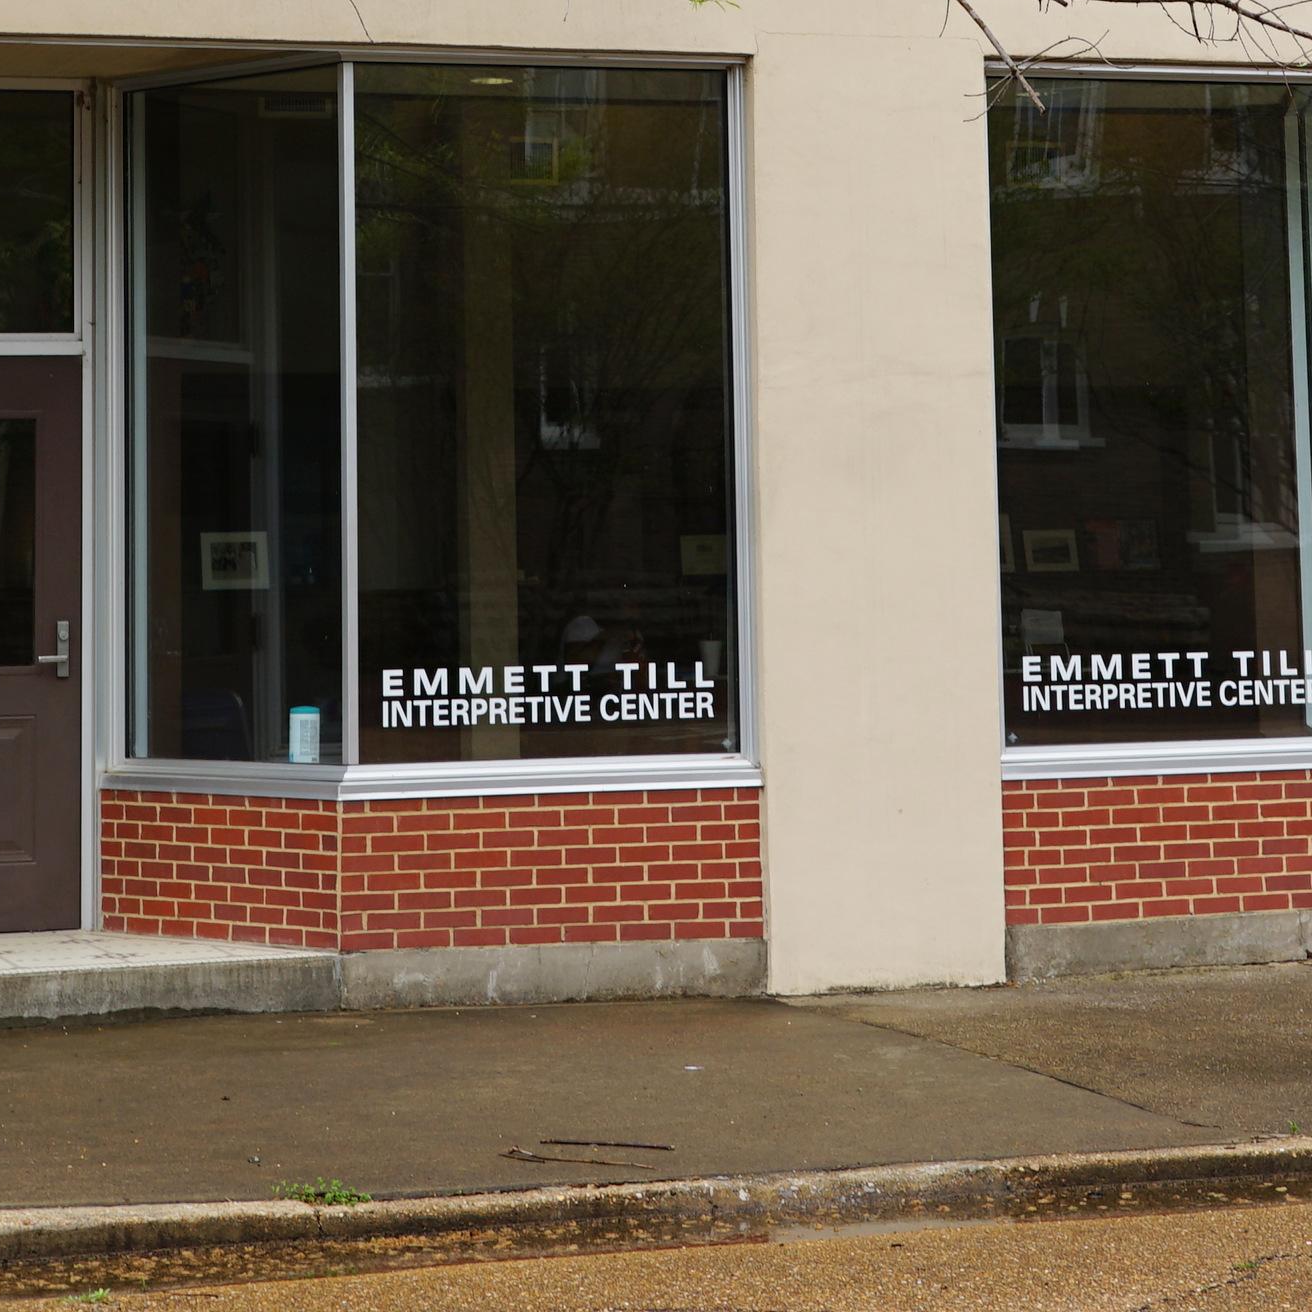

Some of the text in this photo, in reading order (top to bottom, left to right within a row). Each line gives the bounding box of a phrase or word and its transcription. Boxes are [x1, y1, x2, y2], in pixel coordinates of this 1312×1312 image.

[382, 661, 715, 697] EMMETT TILL
[1022, 652, 1209, 682] EMMETT
[382, 691, 715, 728] INTERPRETIVE CENTER
[1023, 681, 1212, 711] INTERPRETIVE
